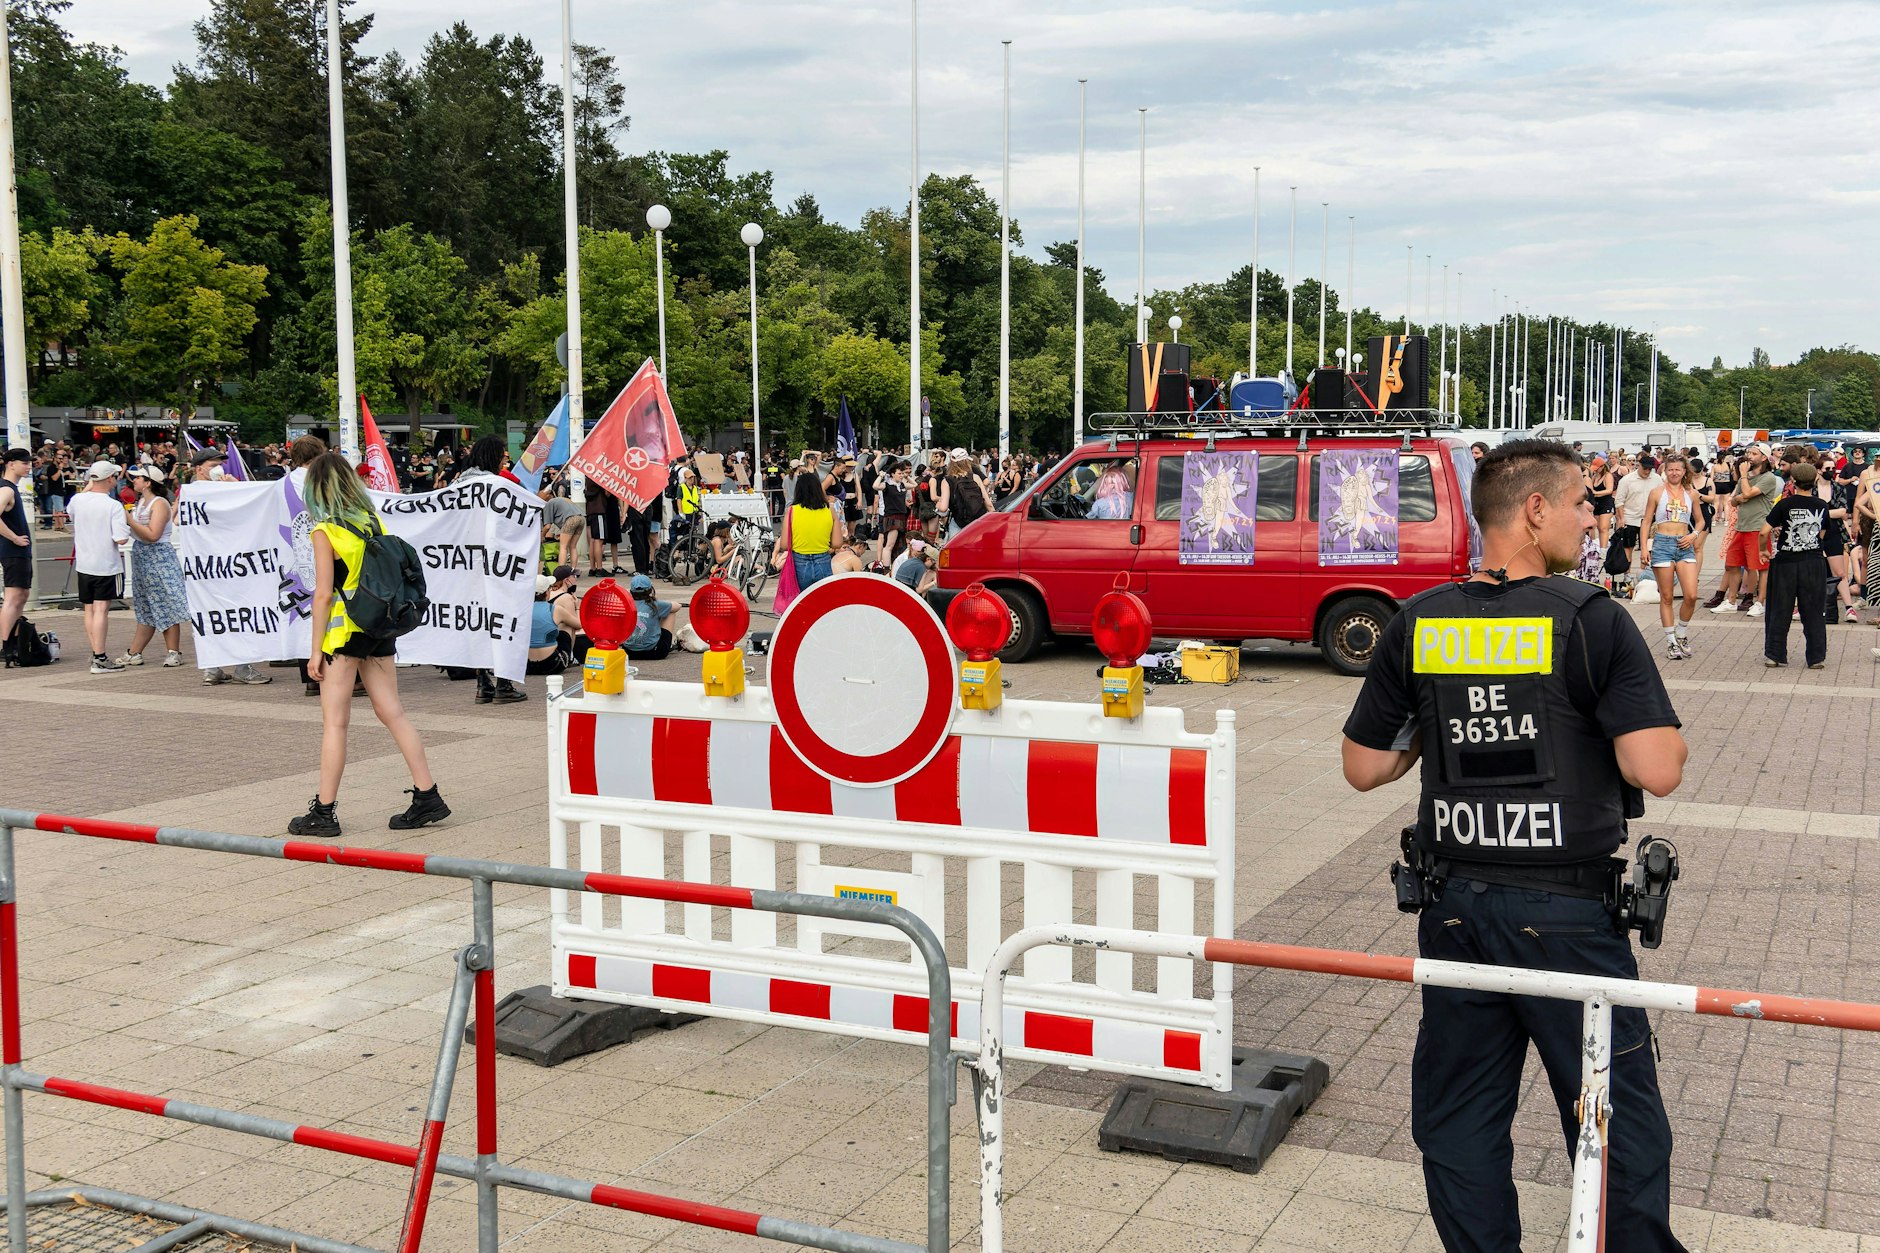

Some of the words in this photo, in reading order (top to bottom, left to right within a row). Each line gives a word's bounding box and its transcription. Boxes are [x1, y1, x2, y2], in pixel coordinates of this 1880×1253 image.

[436, 482, 544, 528] GERICHT
[1421, 625, 1546, 666] POLIZEI
[1467, 684, 1508, 713] BE
[1449, 714, 1538, 744] 36314
[1433, 799, 1563, 847] POLIZEI
